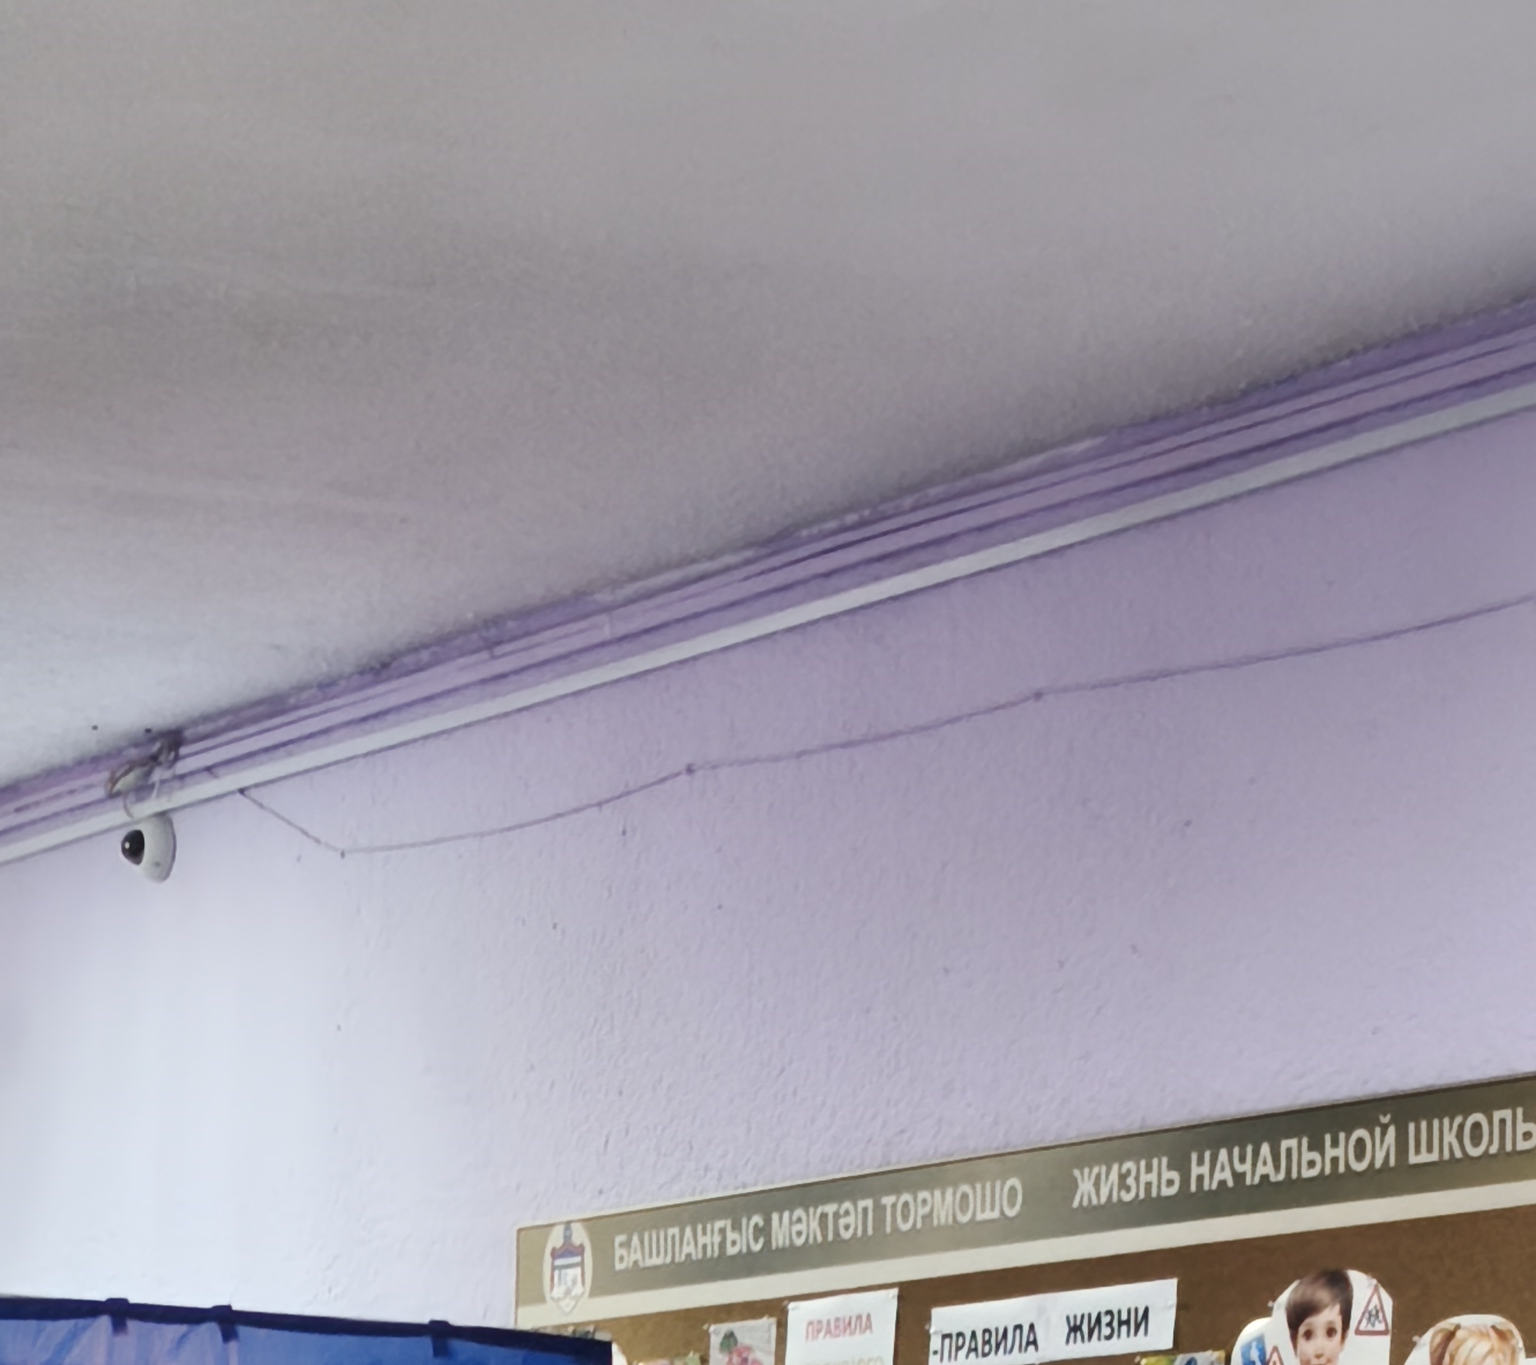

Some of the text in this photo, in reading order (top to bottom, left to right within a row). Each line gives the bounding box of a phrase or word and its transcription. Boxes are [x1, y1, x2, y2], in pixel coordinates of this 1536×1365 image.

[1071, 1155, 1181, 1209] ЖИЗНЬ
[1189, 1112, 1396, 1193] НАЧАЛЬНОЙ
[614, 1176, 1023, 1271] БАШЛАНҒЫС МӘКТӘП ТОРМОШО
[805, 1312, 874, 1343] ПРАВИЛА
[1065, 1304, 1150, 1347] ЖИЗНИ
